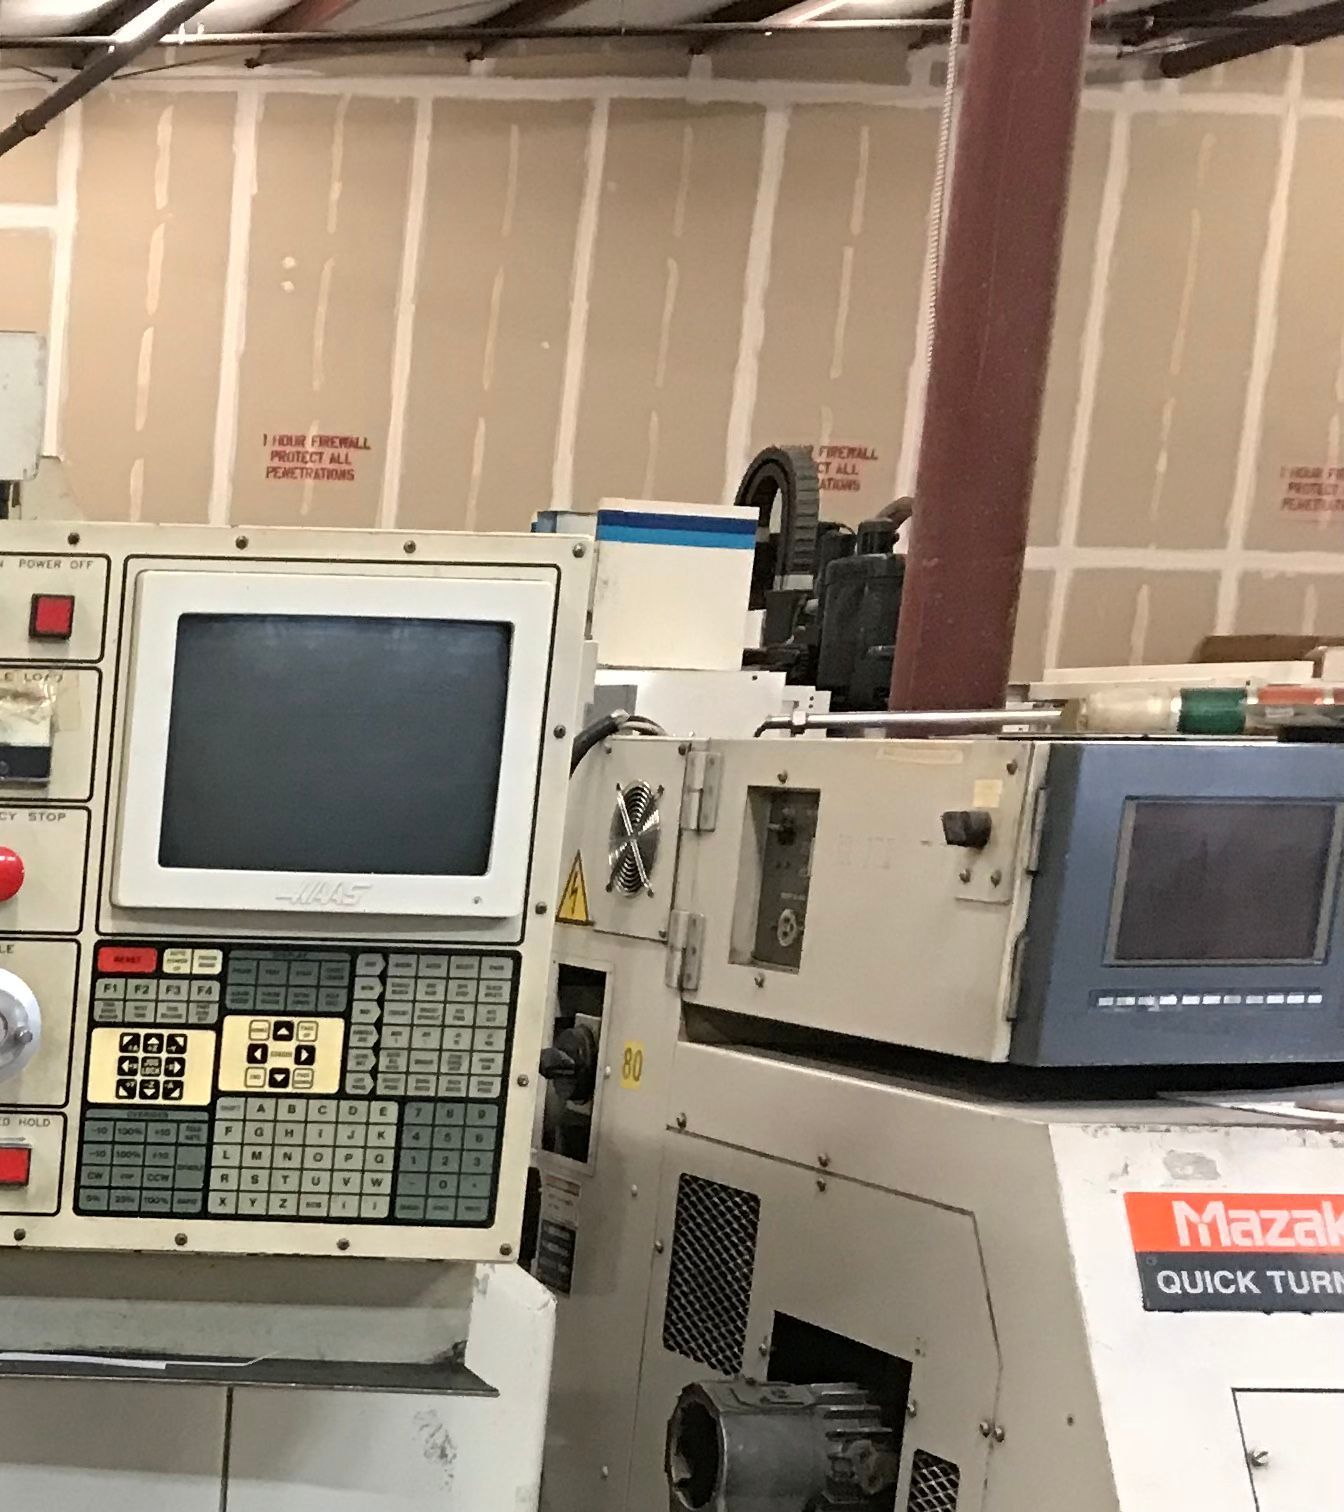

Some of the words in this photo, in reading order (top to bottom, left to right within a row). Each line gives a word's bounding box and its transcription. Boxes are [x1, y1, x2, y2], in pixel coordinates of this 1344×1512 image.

[272, 434, 306, 448] HOUR
[311, 434, 372, 450] FIREWALL
[270, 451, 325, 464] PROTECT
[329, 452, 352, 465] ALL
[265, 466, 355, 481] PENETRATIONS
[836, 463, 859, 476] ALL
[18, 558, 62, 569] POWER
[70, 559, 94, 570] OFF
[28, 812, 67, 822] STOP
[104, 983, 117, 993] F1
[134, 984, 150, 994] F2
[166, 985, 181, 995] F3
[197, 985, 212, 996] F4
[622, 1047, 643, 1082] 80
[19, 1118, 51, 1128] HOLD
[147, 1173, 170, 1182] CCW
[1172, 1200, 1344, 1247] Mazak
[1157, 1270, 1261, 1294] QUICK
